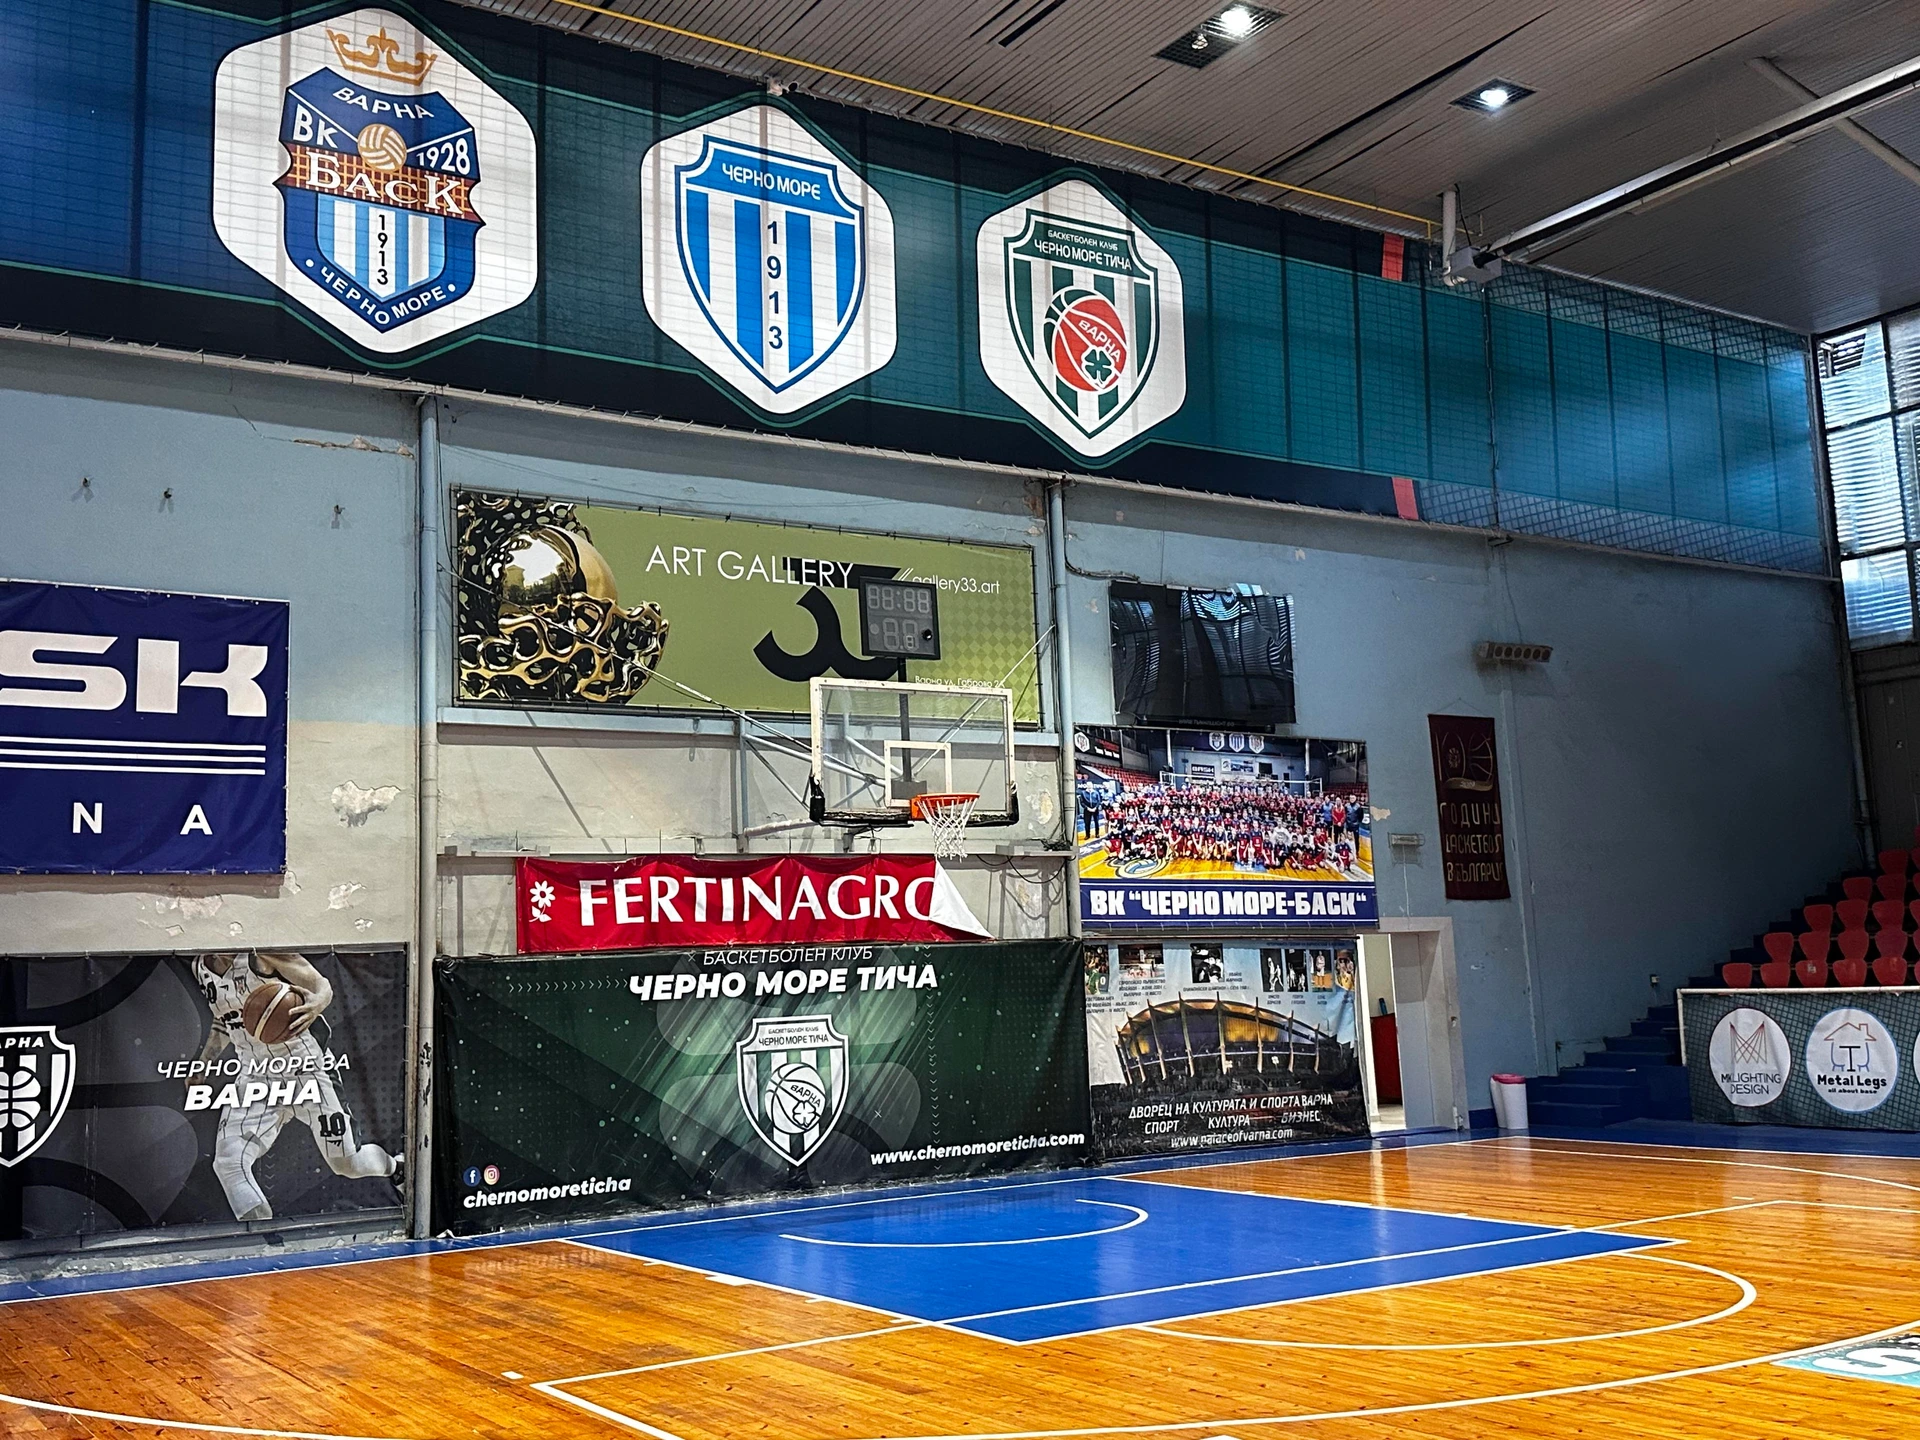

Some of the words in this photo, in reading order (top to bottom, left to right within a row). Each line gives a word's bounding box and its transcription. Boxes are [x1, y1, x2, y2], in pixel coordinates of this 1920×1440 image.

[332, 87, 434, 119] ВАРНА
[292, 104, 339, 149] ВК
[416, 138, 471, 175] 1928
[306, 152, 464, 215] БАСК
[722, 163, 774, 190] ЧЕРНО
[777, 176, 821, 200] МОРЕ
[377, 214, 389, 285] 1913
[1034, 239, 1070, 258] ЧЕРНО
[1072, 247, 1103, 265] МОРЕ
[1103, 253, 1132, 271] ТИЧА
[1048, 230, 1097, 247] БАСКЕТБОЛЕН
[1099, 241, 1118, 251] КЛУБ
[320, 266, 390, 325] ЧЕРНО
[392, 285, 447, 320] МОРЕ
[766, 221, 783, 349] 1913
[1079, 319, 1121, 363] ВАРНА
[645, 544, 706, 577] ART
[717, 550, 854, 590] GALLERY
[1090, 890, 1125, 916] ВК
[703, 948, 826, 966] БАСКЕТБОЛЕН
[830, 946, 873, 960] КЛУБ
[629, 971, 746, 1000] ЧЕРНО
[756, 968, 847, 996] МОРЕ
[855, 964, 938, 991] ТИЧА
[758, 1037, 784, 1046] ЧЕРНО
[786, 1035, 807, 1045] МОРЕ
[808, 1034, 829, 1044] ТИЧА
[156, 1058, 241, 1079] ЧЕРНО
[247, 1056, 319, 1076] МОРЕ
[321, 1054, 350, 1071] ЗА
[1817, 1074, 1854, 1086] Metal
[1856, 1075, 1887, 1089] Legs
[184, 1079, 323, 1111] ВАРНА
[790, 1084, 820, 1108] ВАРНА
[1730, 1084, 1769, 1095] DESIGN
[1129, 1104, 1173, 1120] ДВОРЕЦ
[1175, 1103, 1189, 1115] НА
[1192, 1098, 1246, 1115] КУЛТУРАТА
[1249, 1097, 1257, 1109] И
[1260, 1095, 1300, 1109] СПОРТА
[1302, 1093, 1334, 1106] ВАРНА
[1144, 1120, 1180, 1135] СПОРТ
[1208, 1114, 1250, 1129] КУЛТУРА
[1280, 1110, 1321, 1124] БИЗНЕС
[318, 1112, 346, 1137] 10
[870, 1133, 1085, 1165] www.chernomoreticha.com
[463, 1176, 631, 1208] chernomoreticha
